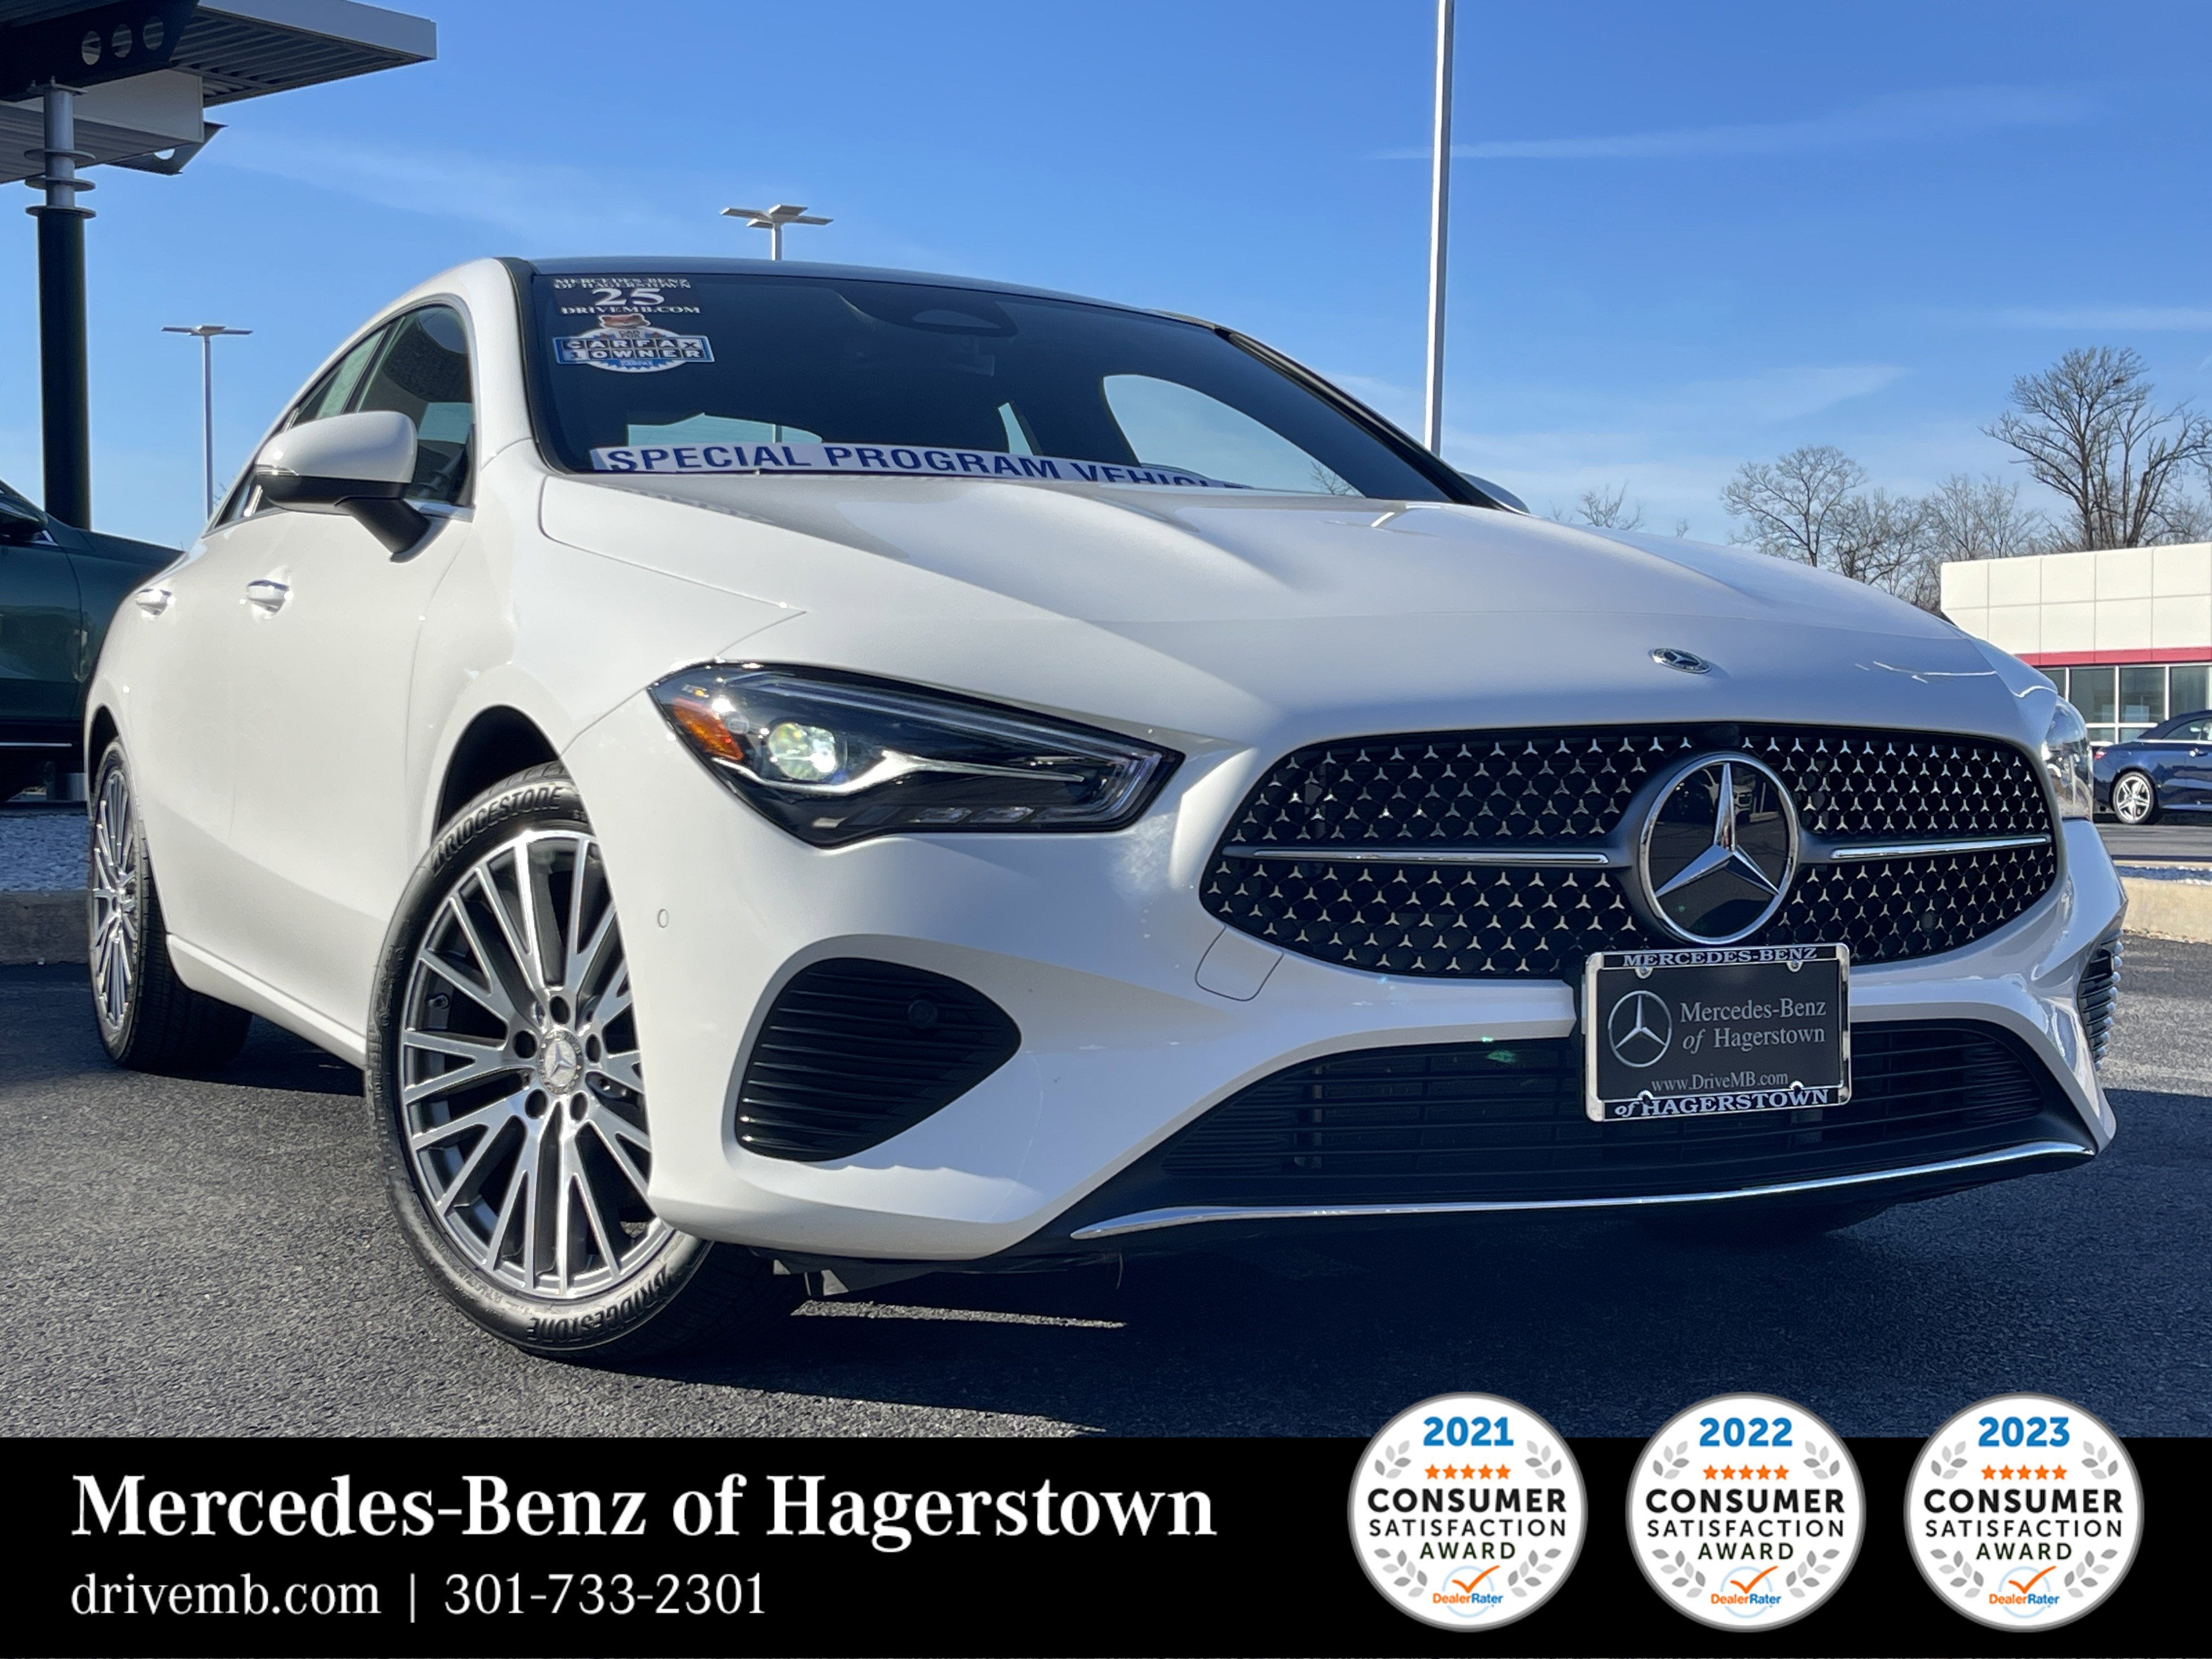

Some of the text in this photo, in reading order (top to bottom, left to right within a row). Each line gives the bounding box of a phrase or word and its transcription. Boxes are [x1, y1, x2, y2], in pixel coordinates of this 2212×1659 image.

[592, 288, 665, 306] 25
[567, 339, 699, 349] CARFAX
[590, 349, 702, 358] OWNER
[607, 445, 811, 471] SPECIAL
[824, 446, 1062, 479] PROGRAM
[432, 786, 565, 878] BRIDGESTONE
[1622, 947, 1818, 967] MERCEDES-BENZ
[1680, 997, 1827, 1023] Mercedes-Benz
[1682, 1025, 1826, 1054] of Hagerstown
[1651, 1070, 1789, 1092] www.DriveMB.com
[1614, 1088, 1830, 1118] of HAGERSTOWN
